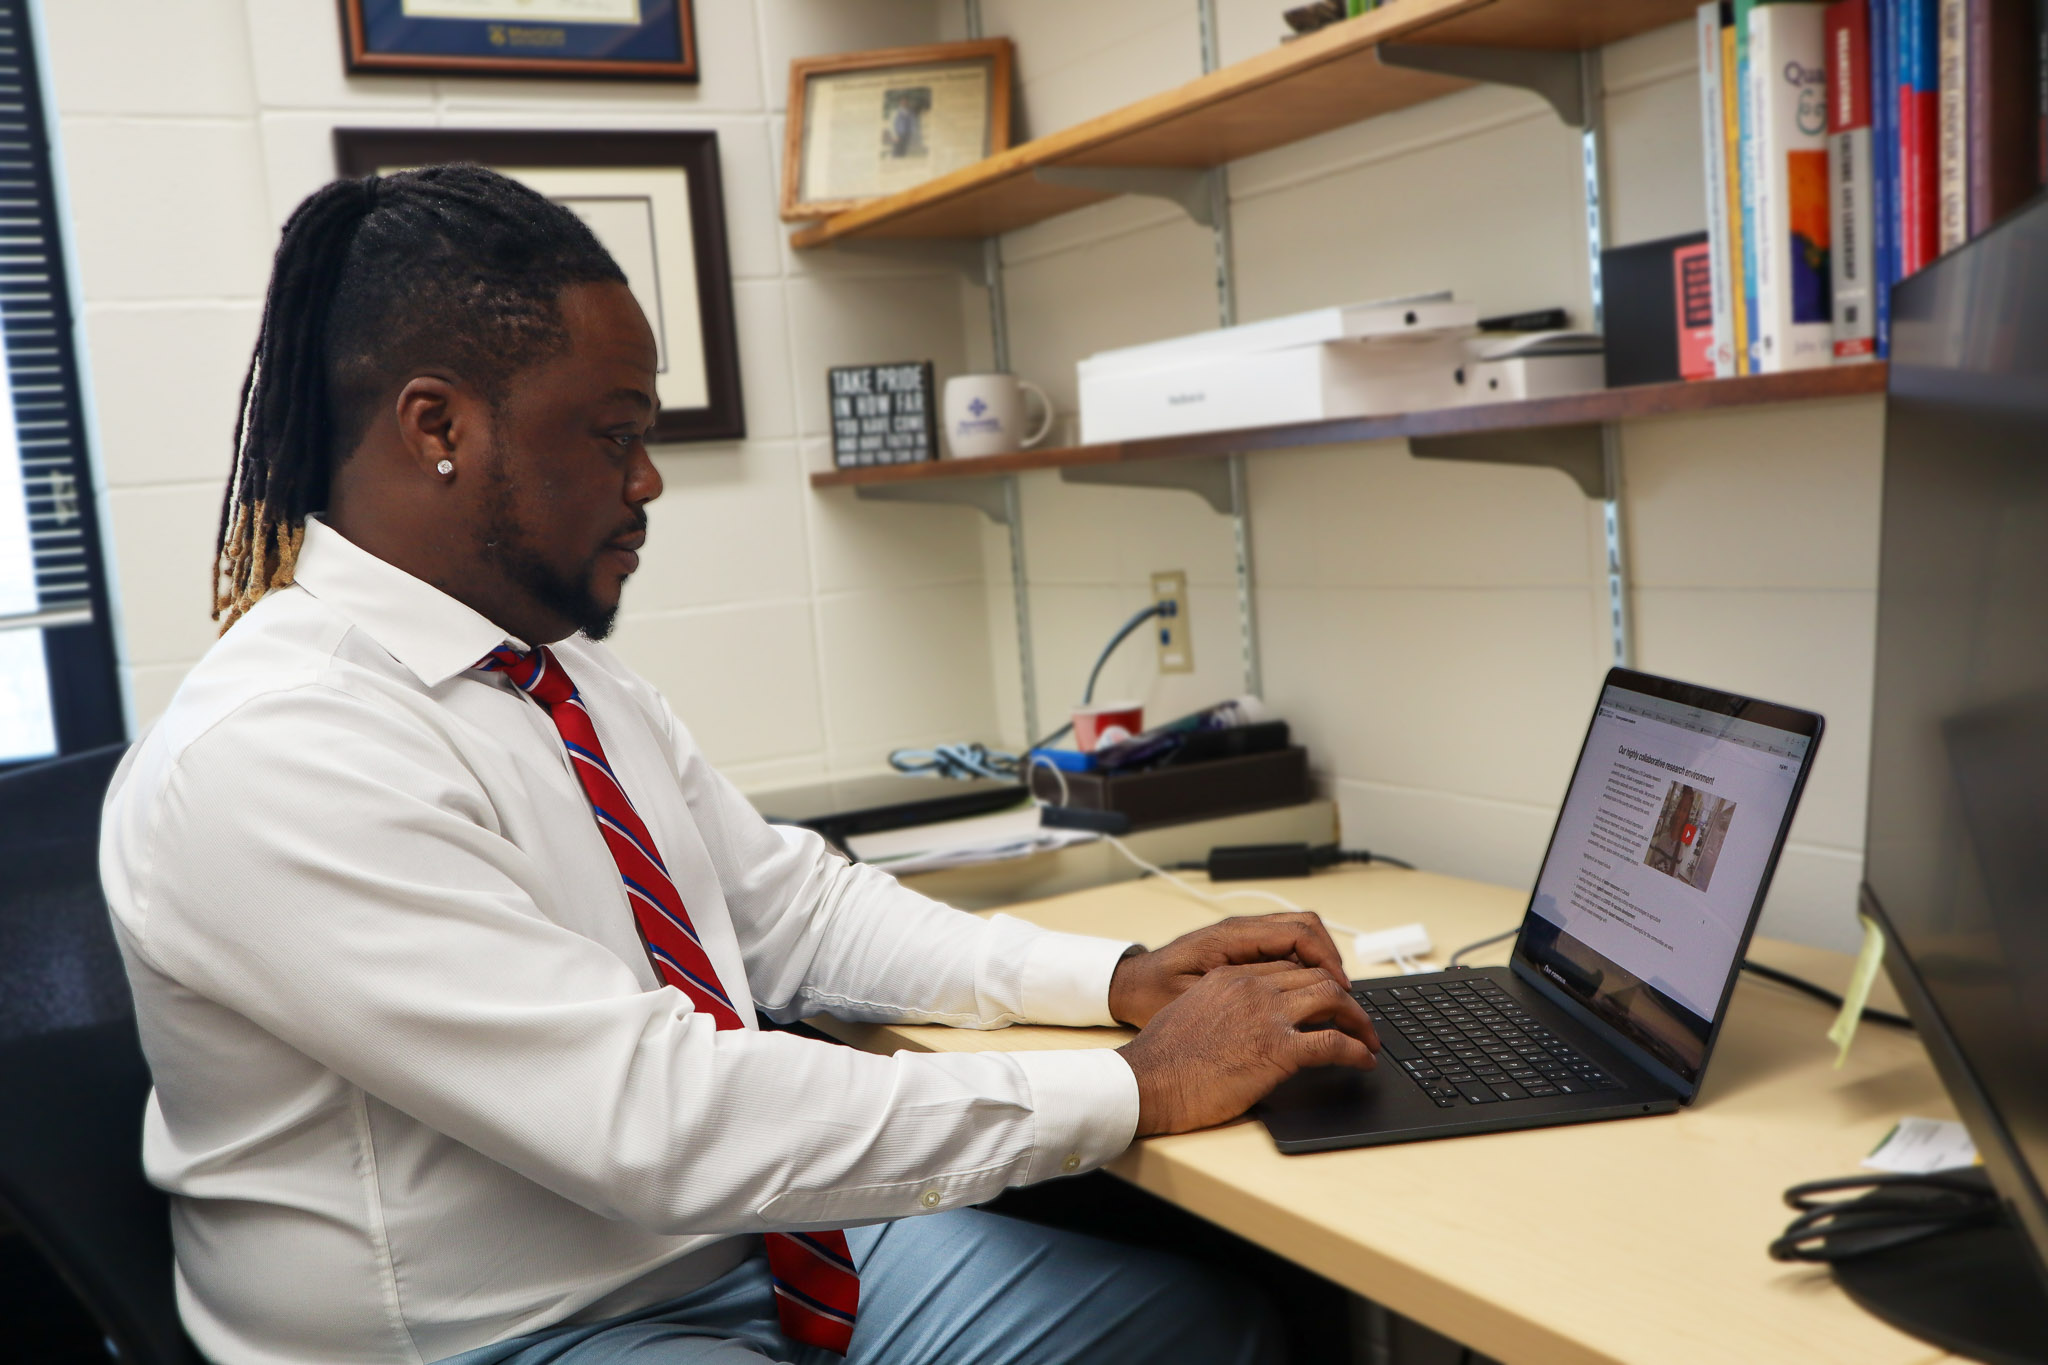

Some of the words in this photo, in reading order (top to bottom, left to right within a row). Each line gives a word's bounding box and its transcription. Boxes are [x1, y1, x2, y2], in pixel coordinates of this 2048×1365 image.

[1840, 133, 1853, 182] CULTURE
[1842, 211, 1855, 281] LEADERSHIP
[832, 369, 871, 395] TAKE
[876, 365, 923, 393] PRIDE
[834, 396, 852, 417] IN
[856, 394, 890, 416] HOW
[895, 391, 924, 412] FAR
[862, 417, 890, 433] HAVE
[894, 415, 925, 433] COME
[1618, 744, 1626, 754] Our
[1625, 747, 1639, 760] highly
[1639, 752, 1665, 768] collaborative
[1665, 761, 1685, 775] research
[1685, 768, 1715, 785] environment
